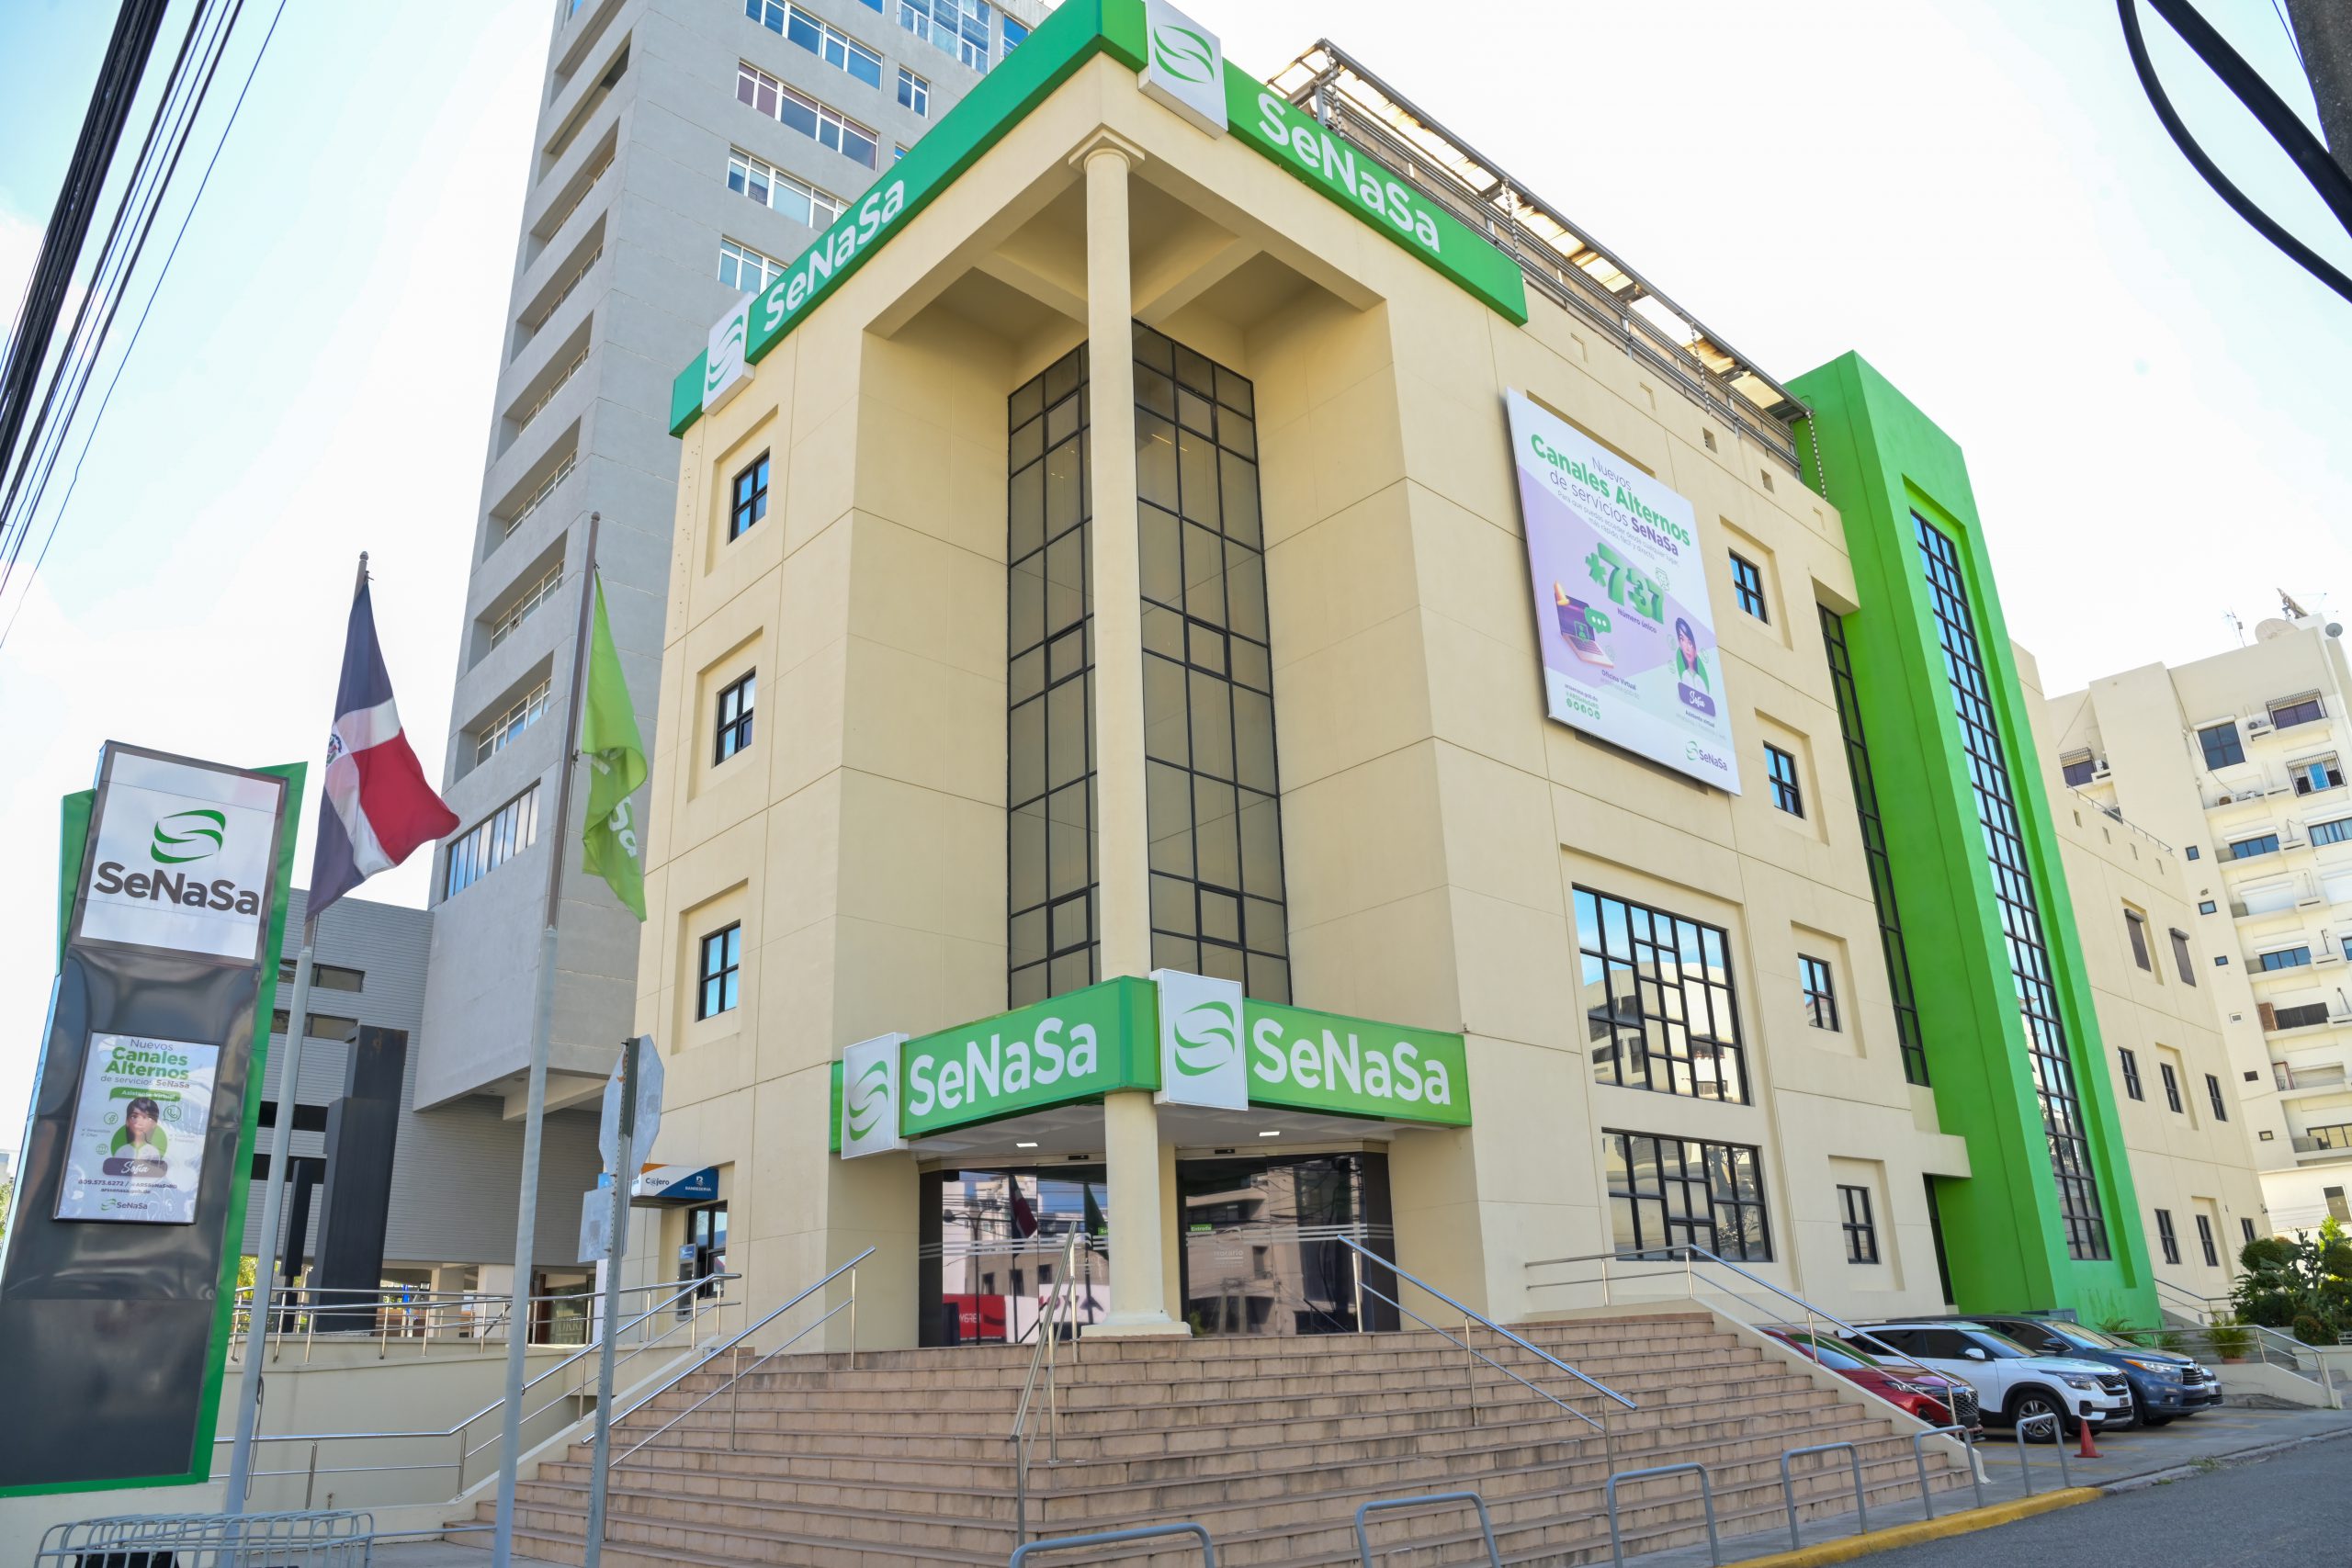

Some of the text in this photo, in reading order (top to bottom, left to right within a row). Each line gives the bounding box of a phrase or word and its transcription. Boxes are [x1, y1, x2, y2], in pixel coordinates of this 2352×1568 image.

[1257, 92, 1441, 254] SeNaSa
[763, 180, 904, 332] SeNaSa
[1591, 457, 1632, 491] Nuevos
[1531, 434, 1690, 547] Canales Alternos
[1550, 469, 1679, 557] de servicios SeNaSa
[1617, 607, 1657, 634] Número único
[1601, 669, 1619, 682] Oficina
[1619, 677, 1636, 691] Virtual
[1699, 749, 1728, 772] SeNaSa
[94, 861, 259, 916] SeNaSa
[112, 1046, 188, 1066] Canales
[130, 1038, 174, 1051] Nuevos
[105, 1060, 189, 1080] Alternos
[908, 1017, 1098, 1116] SeNaSa
[1252, 1018, 1452, 1105] SeNaSa
[121, 1089, 152, 1098] Asistente
[155, 1079, 190, 1089] SeNaSa
[116, 1201, 148, 1210] SeNaSa
